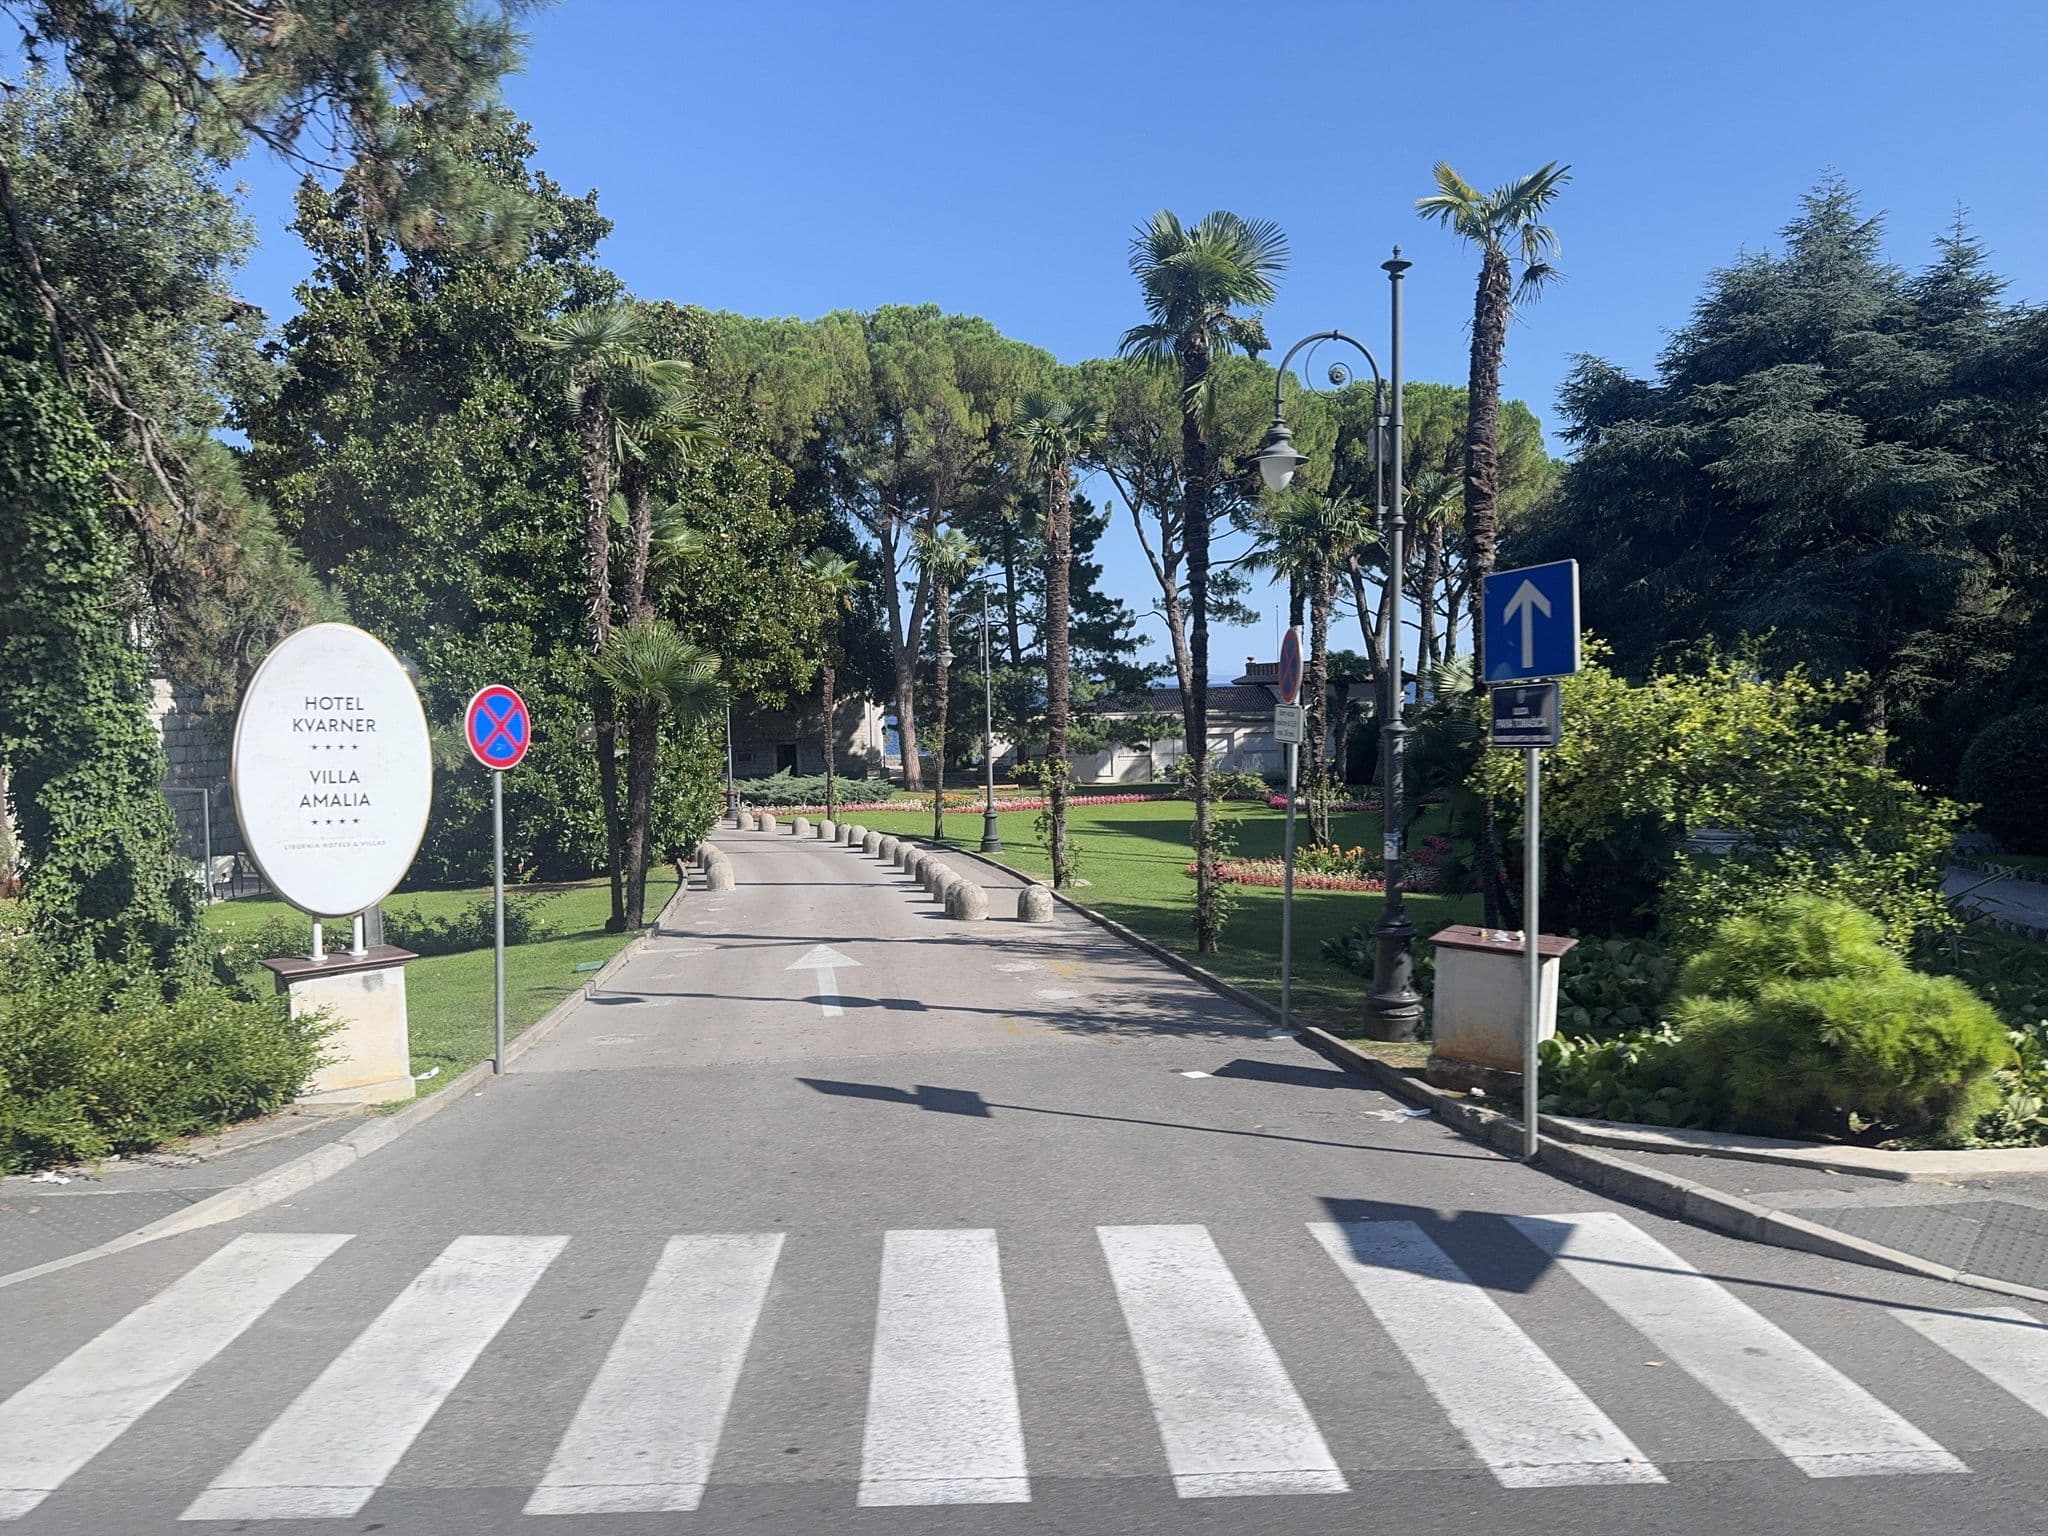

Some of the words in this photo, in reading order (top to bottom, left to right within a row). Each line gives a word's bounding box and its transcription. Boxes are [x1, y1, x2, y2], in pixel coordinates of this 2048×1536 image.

[305, 697, 365, 710] HOTEL
[292, 719, 376, 732] KVARNER
[309, 770, 361, 784] VILLA
[299, 792, 371, 808] AMALIA
[322, 841, 351, 849] HOTELS
